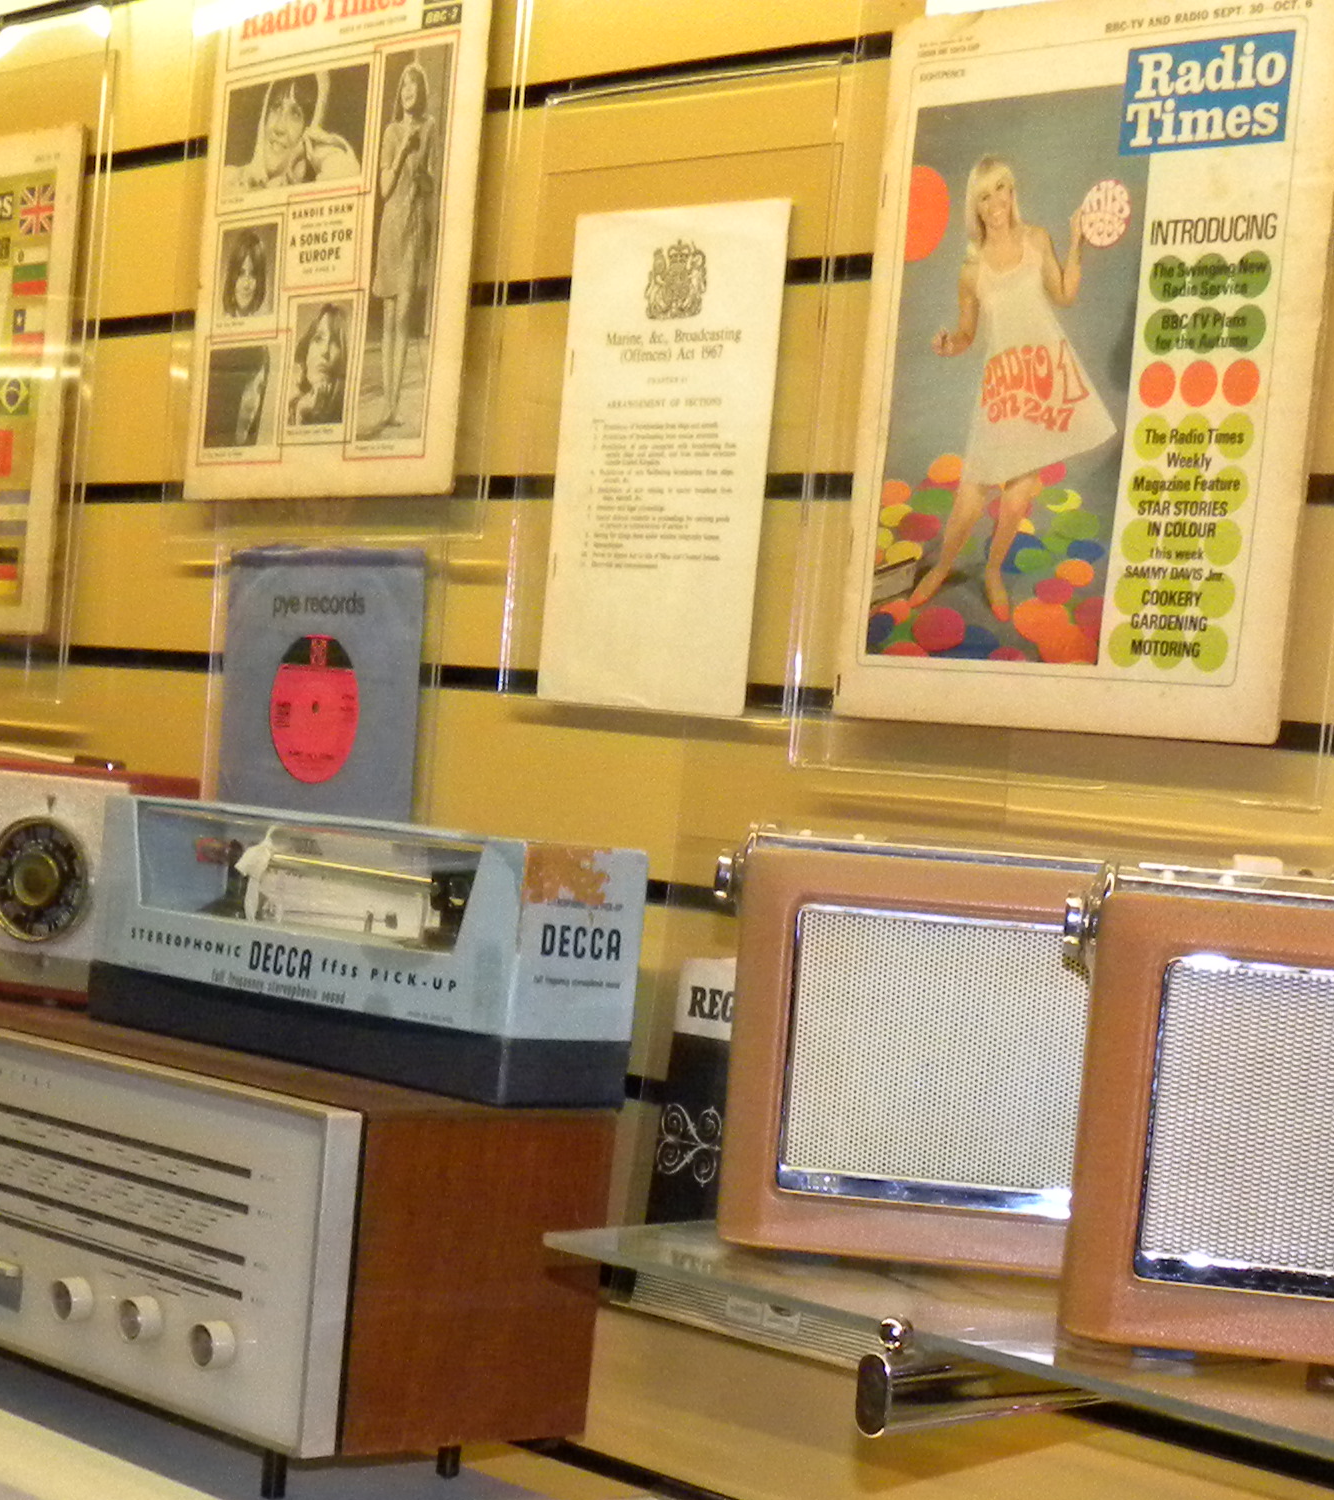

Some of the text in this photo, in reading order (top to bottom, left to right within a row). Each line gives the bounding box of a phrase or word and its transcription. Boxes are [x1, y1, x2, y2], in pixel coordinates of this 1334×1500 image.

[1148, 16, 1171, 28] AND
[1174, 11, 1209, 24] RADIO
[1135, 42, 1287, 99] Radio
[1126, 97, 1280, 149] Times
[328, 203, 354, 215] SHAW
[290, 228, 353, 247] A SONG FOR
[1150, 213, 1278, 246] INTRODUCING
[299, 247, 341, 264] EUROPE
[1153, 262, 1175, 279] The
[1162, 280, 1248, 298] Radio Service
[1161, 311, 1246, 330] BBC TV Plans
[606, 328, 742, 347] Marine, Broadcasting
[1155, 334, 1172, 351] for
[1175, 333, 1195, 349] the
[620, 345, 724, 364] (Offences) Act 1967
[1023, 400, 1075, 432] 247
[1145, 428, 1244, 445] The Radio Times
[1167, 453, 1212, 471] Weekly
[1132, 475, 1241, 496] Magazine Feature
[1138, 501, 1228, 517] STAR STORIES
[1147, 521, 1216, 538] IN COLOUR
[1150, 547, 1204, 560] this week
[1124, 565, 1203, 581] SAMMY DAVIS
[272, 592, 366, 618] pye records
[1141, 590, 1203, 606] COOKERY
[1131, 613, 1208, 632] GARDENING
[1130, 639, 1201, 658] MOTORING
[540, 923, 622, 962] DECCA
[130, 926, 457, 993] STEREOPHONIC DECCA ffss PICK-UP
